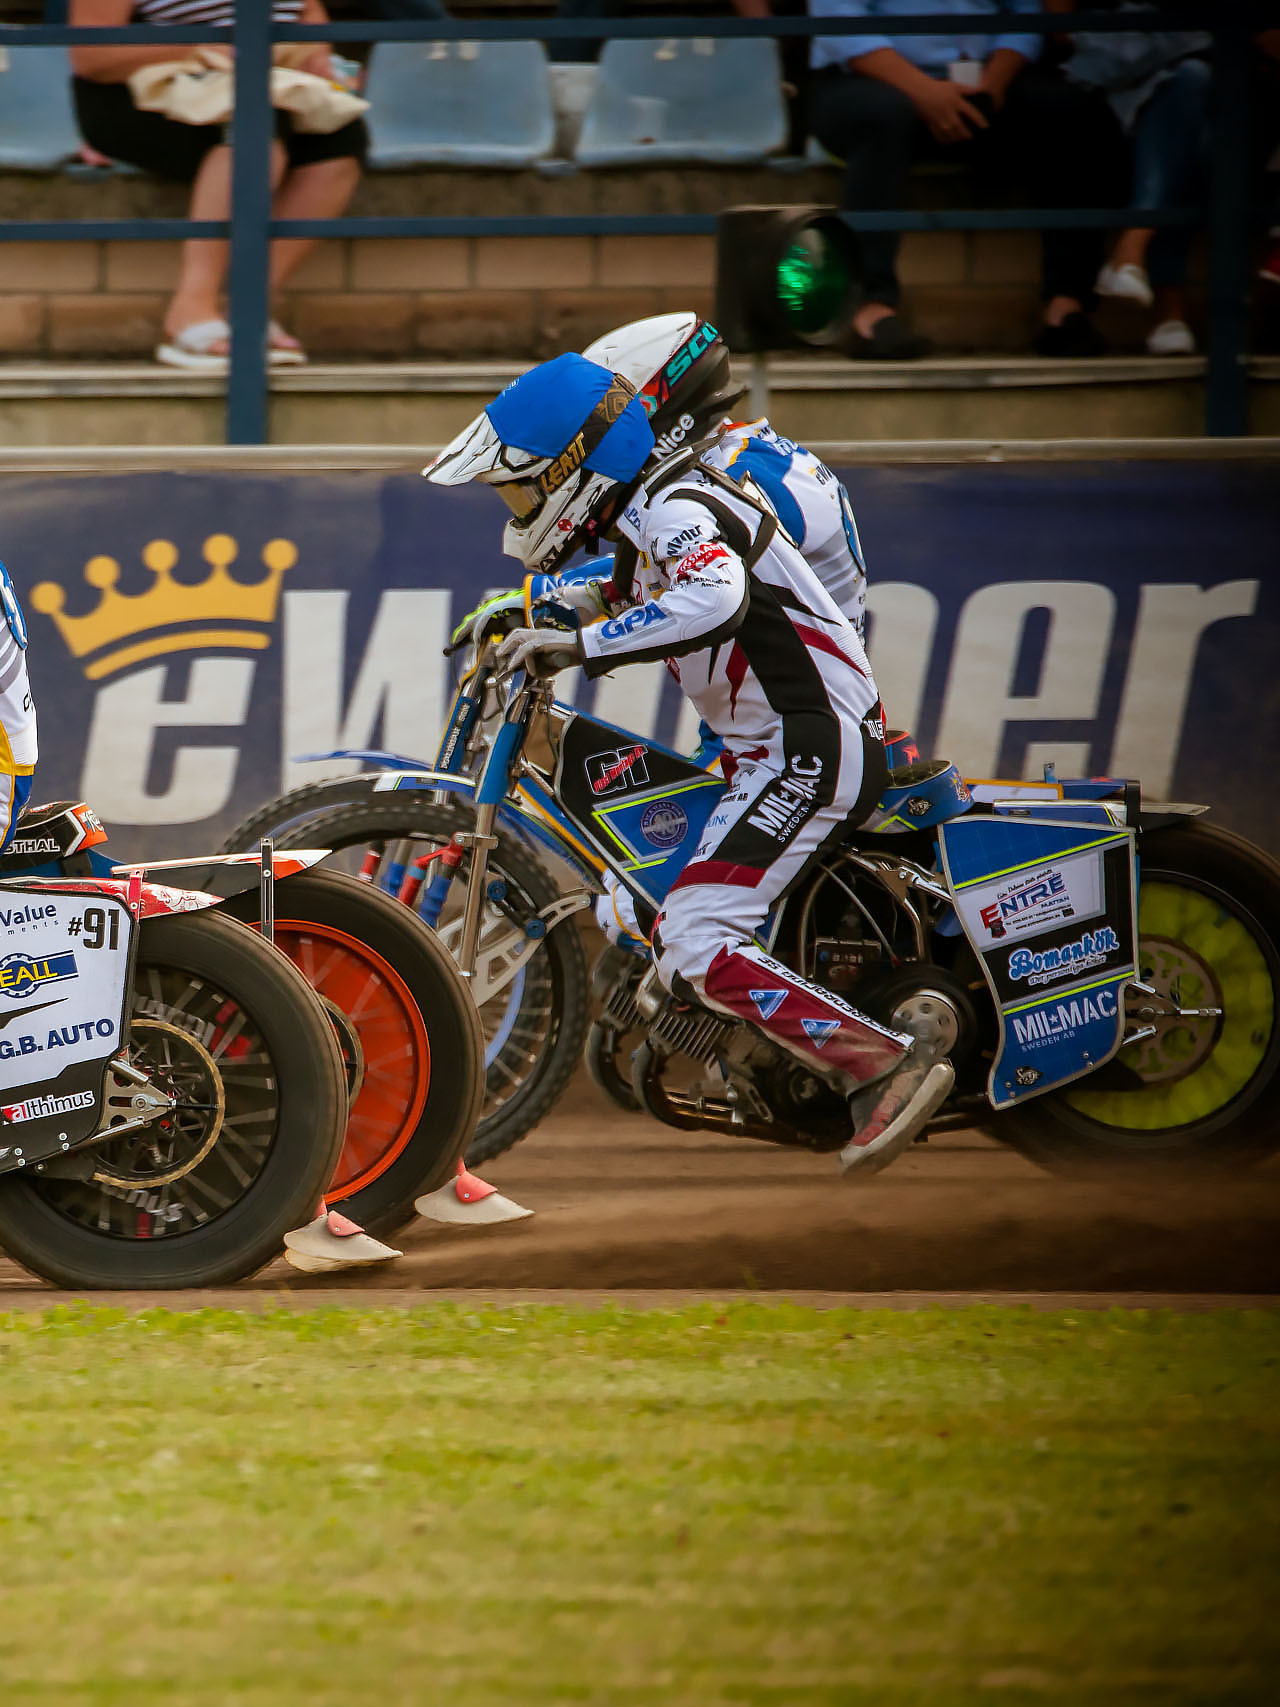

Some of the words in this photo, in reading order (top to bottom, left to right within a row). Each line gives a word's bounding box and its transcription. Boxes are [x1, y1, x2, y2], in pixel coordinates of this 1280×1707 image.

[667, 320, 719, 387] SCO
[652, 413, 695, 460] Nice
[601, 602, 668, 640] GPA
[68, 907, 120, 951] #91
[1010, 926, 1119, 980] Bomankök
[47, 1018, 115, 1050] AUTO
[1021, 1036, 1060, 1053] SWEDEN
[1063, 1030, 1076, 1039] AB
[1, 1091, 95, 1125] althimus
